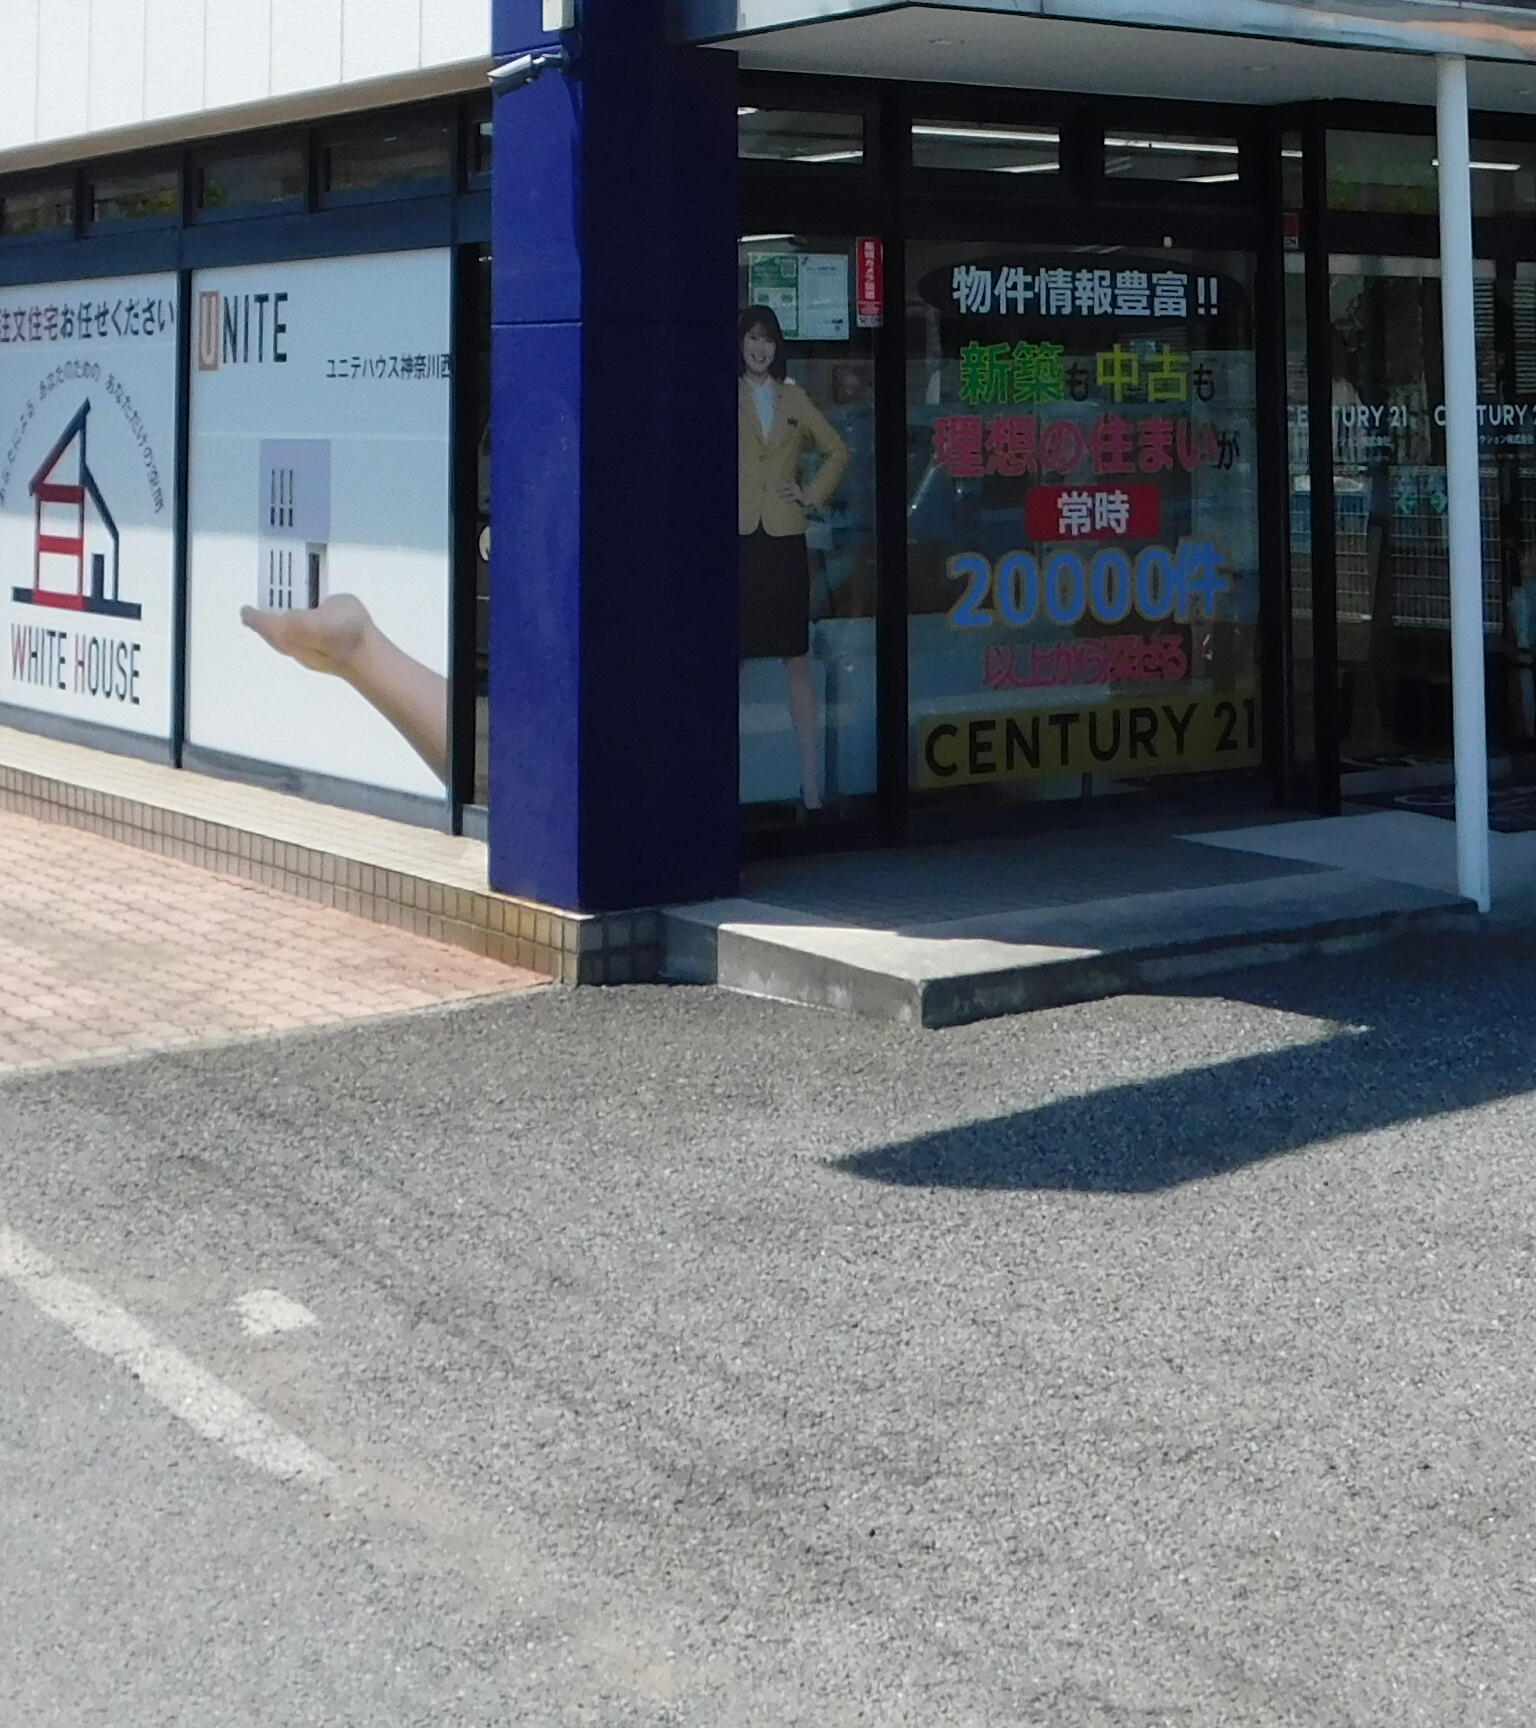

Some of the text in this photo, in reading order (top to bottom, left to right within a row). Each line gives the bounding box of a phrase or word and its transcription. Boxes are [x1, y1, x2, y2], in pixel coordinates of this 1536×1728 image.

[198, 289, 290, 372] UNITE
[1388, 404, 1408, 428] 21
[1056, 490, 1131, 536] 常時
[946, 536, 1233, 629] 20000件
[10, 622, 142, 706] WHITE HOUSE
[923, 697, 1256, 778] CENTURY 21
